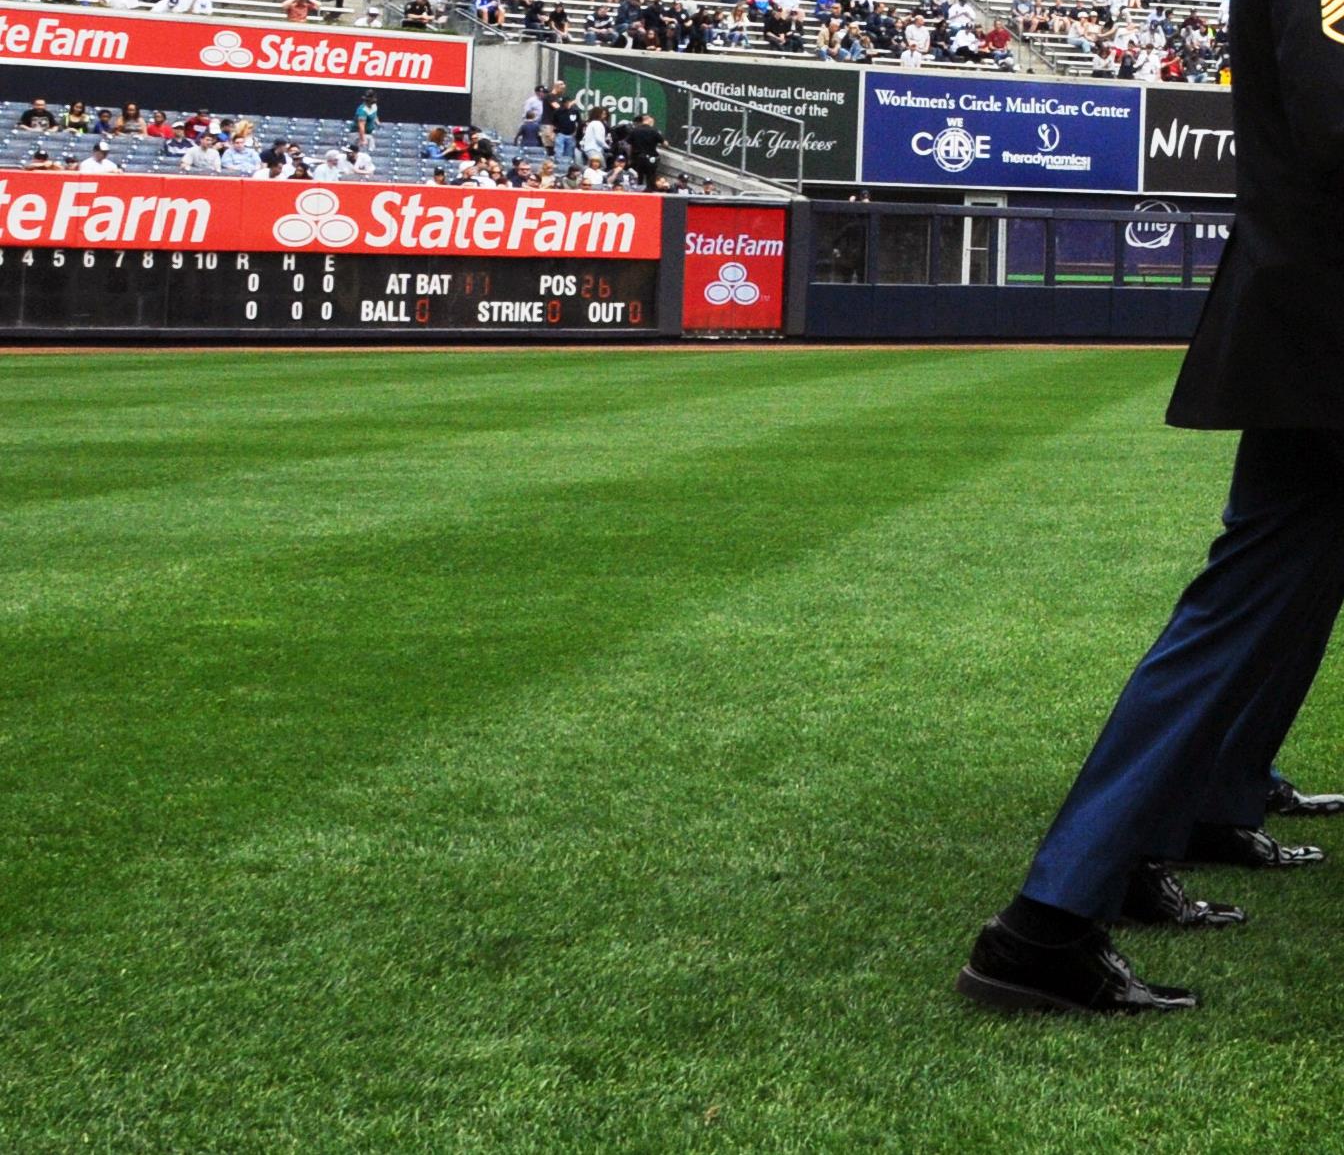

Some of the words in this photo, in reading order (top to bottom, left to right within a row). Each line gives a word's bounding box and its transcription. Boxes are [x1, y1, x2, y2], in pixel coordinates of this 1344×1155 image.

[575, 88, 648, 114] Clean
[700, 81, 745, 97] Official
[747, 84, 792, 100] Natural
[793, 87, 846, 105] Cleaning
[875, 89, 955, 111] Workmen's
[959, 94, 1002, 113] Circle
[1006, 97, 1079, 117] MultiCare
[1081, 99, 1131, 119] Center
[794, 103, 807, 116] of
[808, 104, 829, 117] the
[946, 117, 964, 128] WE
[681, 125, 722, 146] New
[721, 127, 766, 157] York
[765, 130, 838, 159] Yankees
[22, 249, 35, 267] 4
[53, 249, 66, 268] 5
[83, 250, 96, 268] 6
[114, 250, 126, 268] 7
[142, 250, 155, 269] 8
[171, 251, 184, 270] 9
[195, 251, 218, 270] 10
[236, 254, 250, 270] R
[283, 254, 296, 271] H
[324, 254, 336, 272] E
[248, 273, 260, 293] 0
[293, 273, 304, 293] 0
[322, 273, 335, 293] 0
[386, 273, 411, 296] AT
[415, 274, 453, 296] BAT
[539, 275, 577, 297] POS
[245, 300, 258, 320] 0
[291, 301, 303, 320] 0
[321, 301, 333, 321] 0
[360, 300, 411, 323] BALL
[477, 301, 544, 323] STRIKE
[588, 302, 625, 324] OUT
